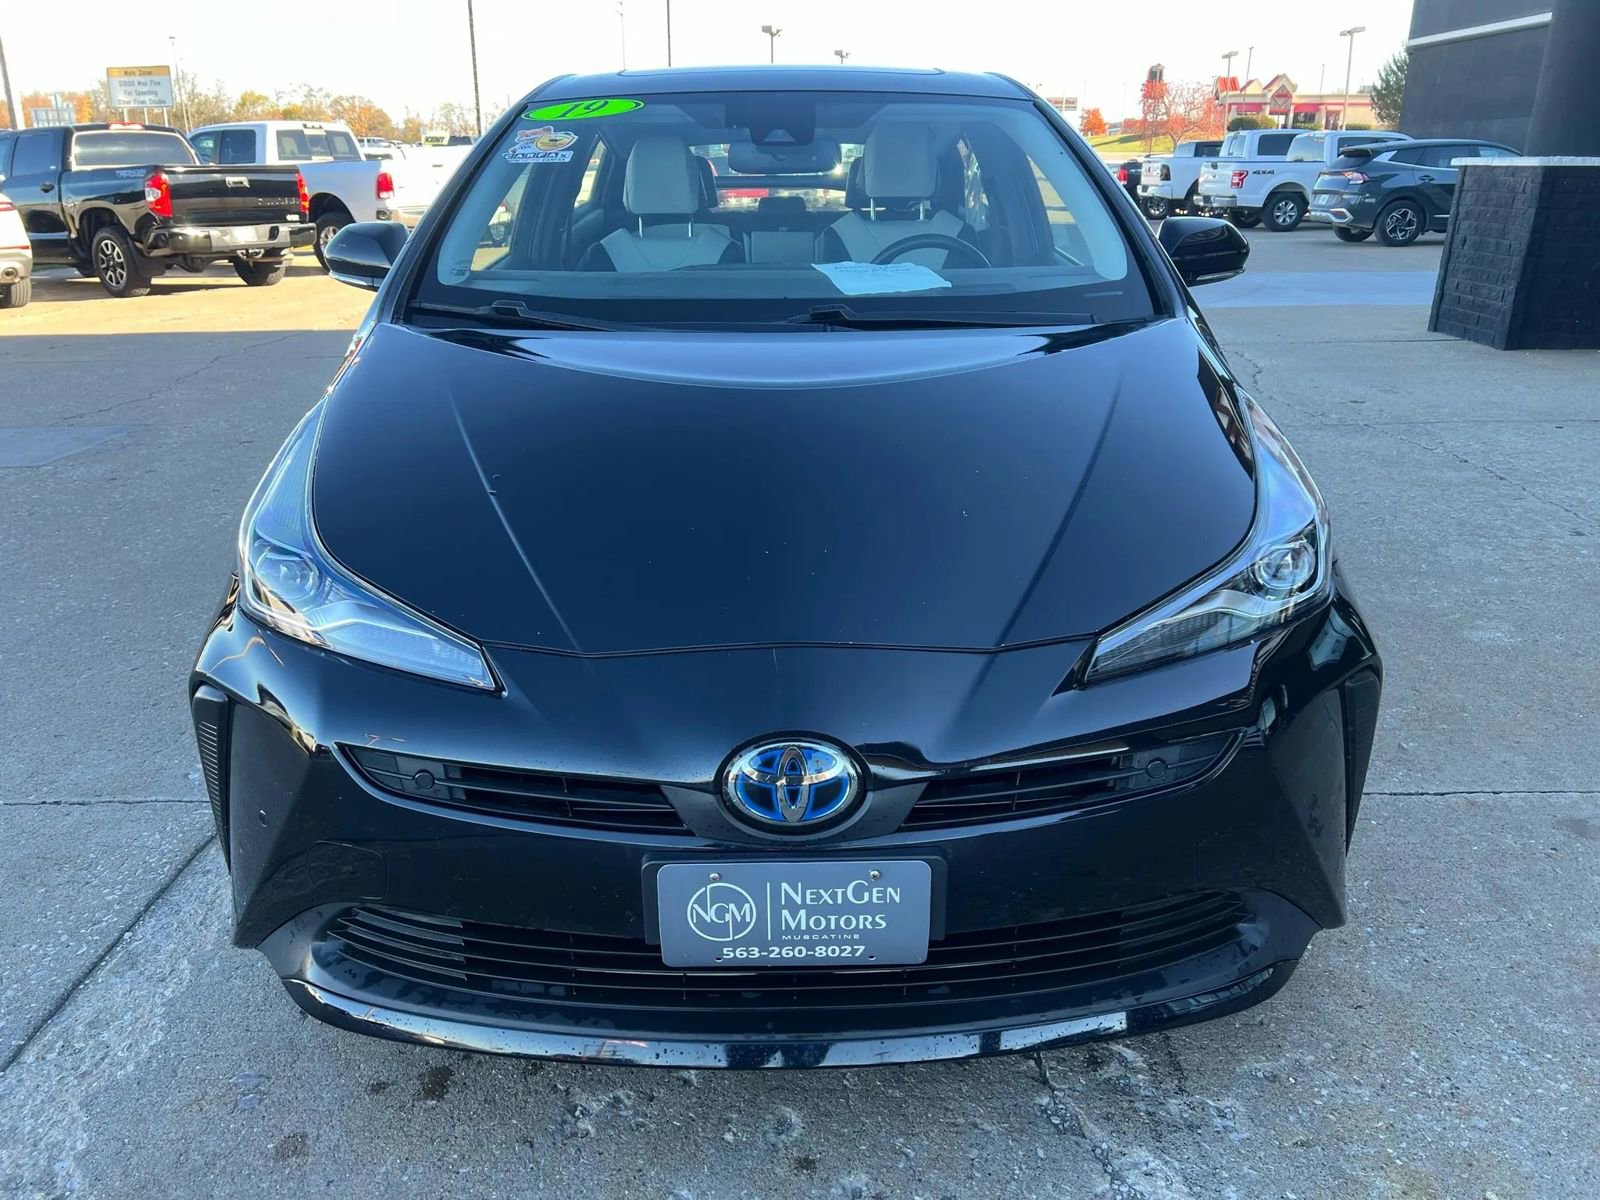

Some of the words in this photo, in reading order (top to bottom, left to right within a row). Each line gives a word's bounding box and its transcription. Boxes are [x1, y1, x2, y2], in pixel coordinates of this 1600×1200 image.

[135, 89, 158, 97] Speeding
[558, 100, 609, 118] 19
[722, 945, 866, 959] 563-260-8027
